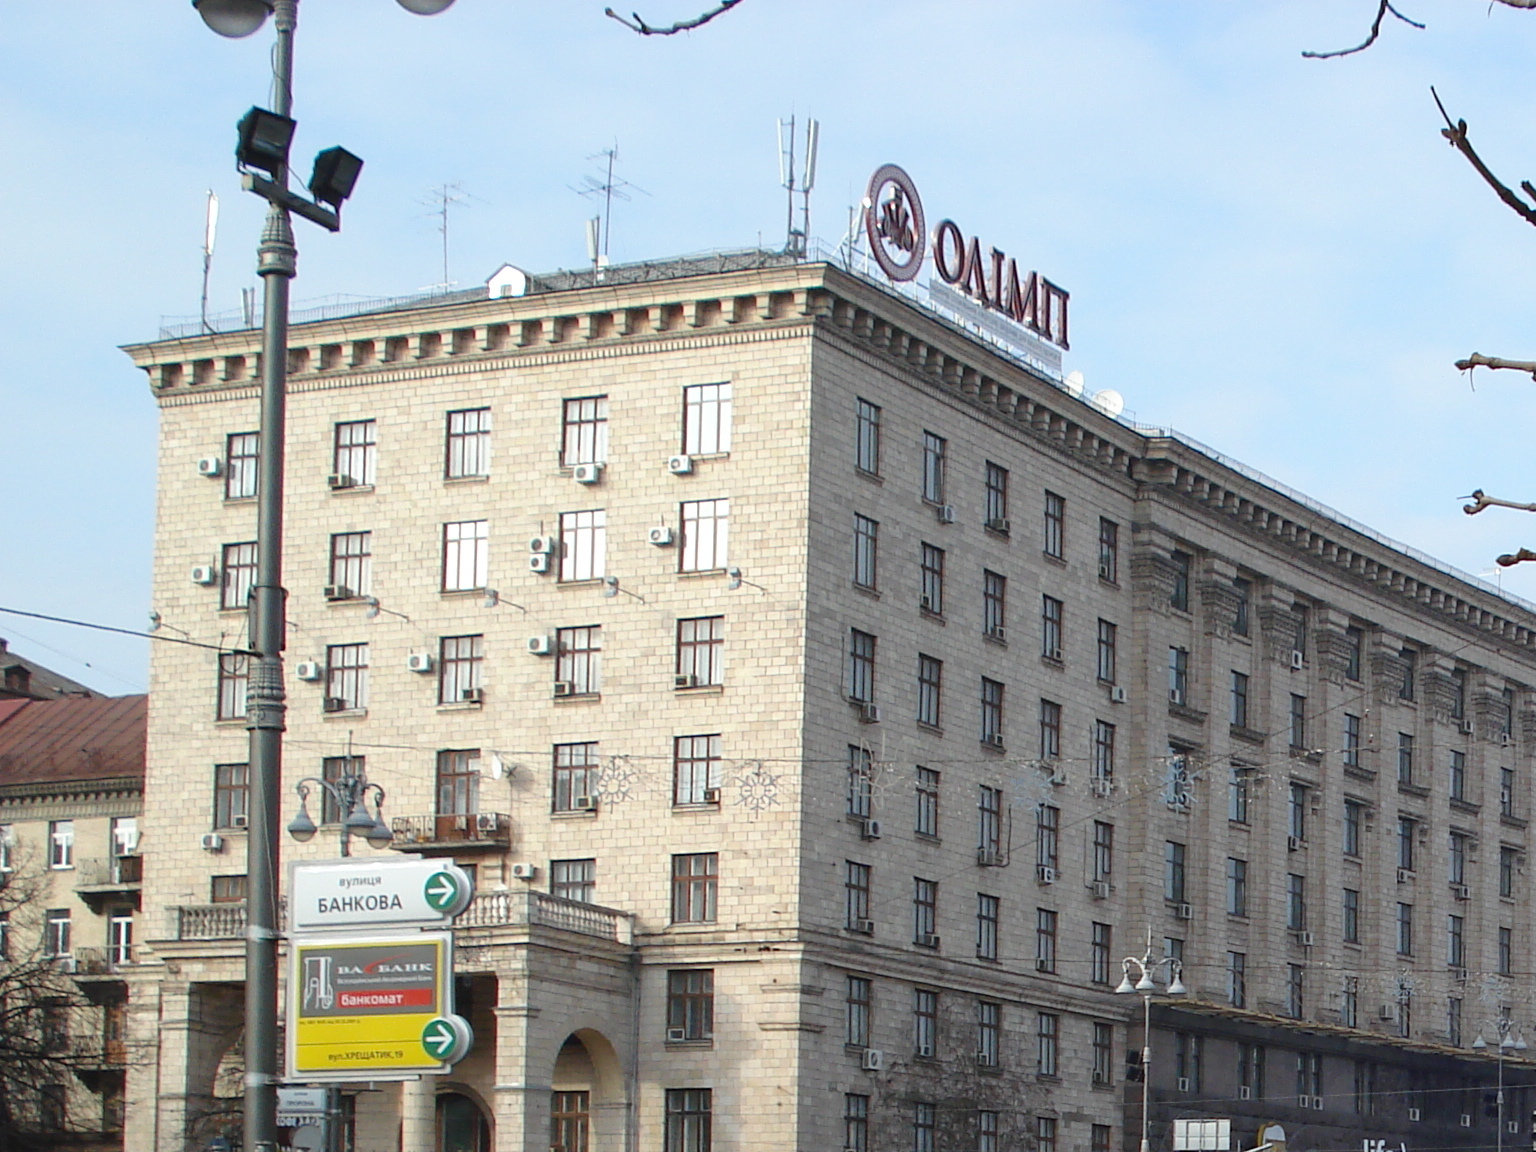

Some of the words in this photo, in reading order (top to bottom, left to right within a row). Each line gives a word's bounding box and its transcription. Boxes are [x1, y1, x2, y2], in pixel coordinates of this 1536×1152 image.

[339, 876, 382, 888] вулиця
[318, 894, 403, 914] БАНКОВА
[337, 965, 364, 975] ВА
[378, 962, 433, 974] БАНК
[340, 994, 404, 1006] банкомат
